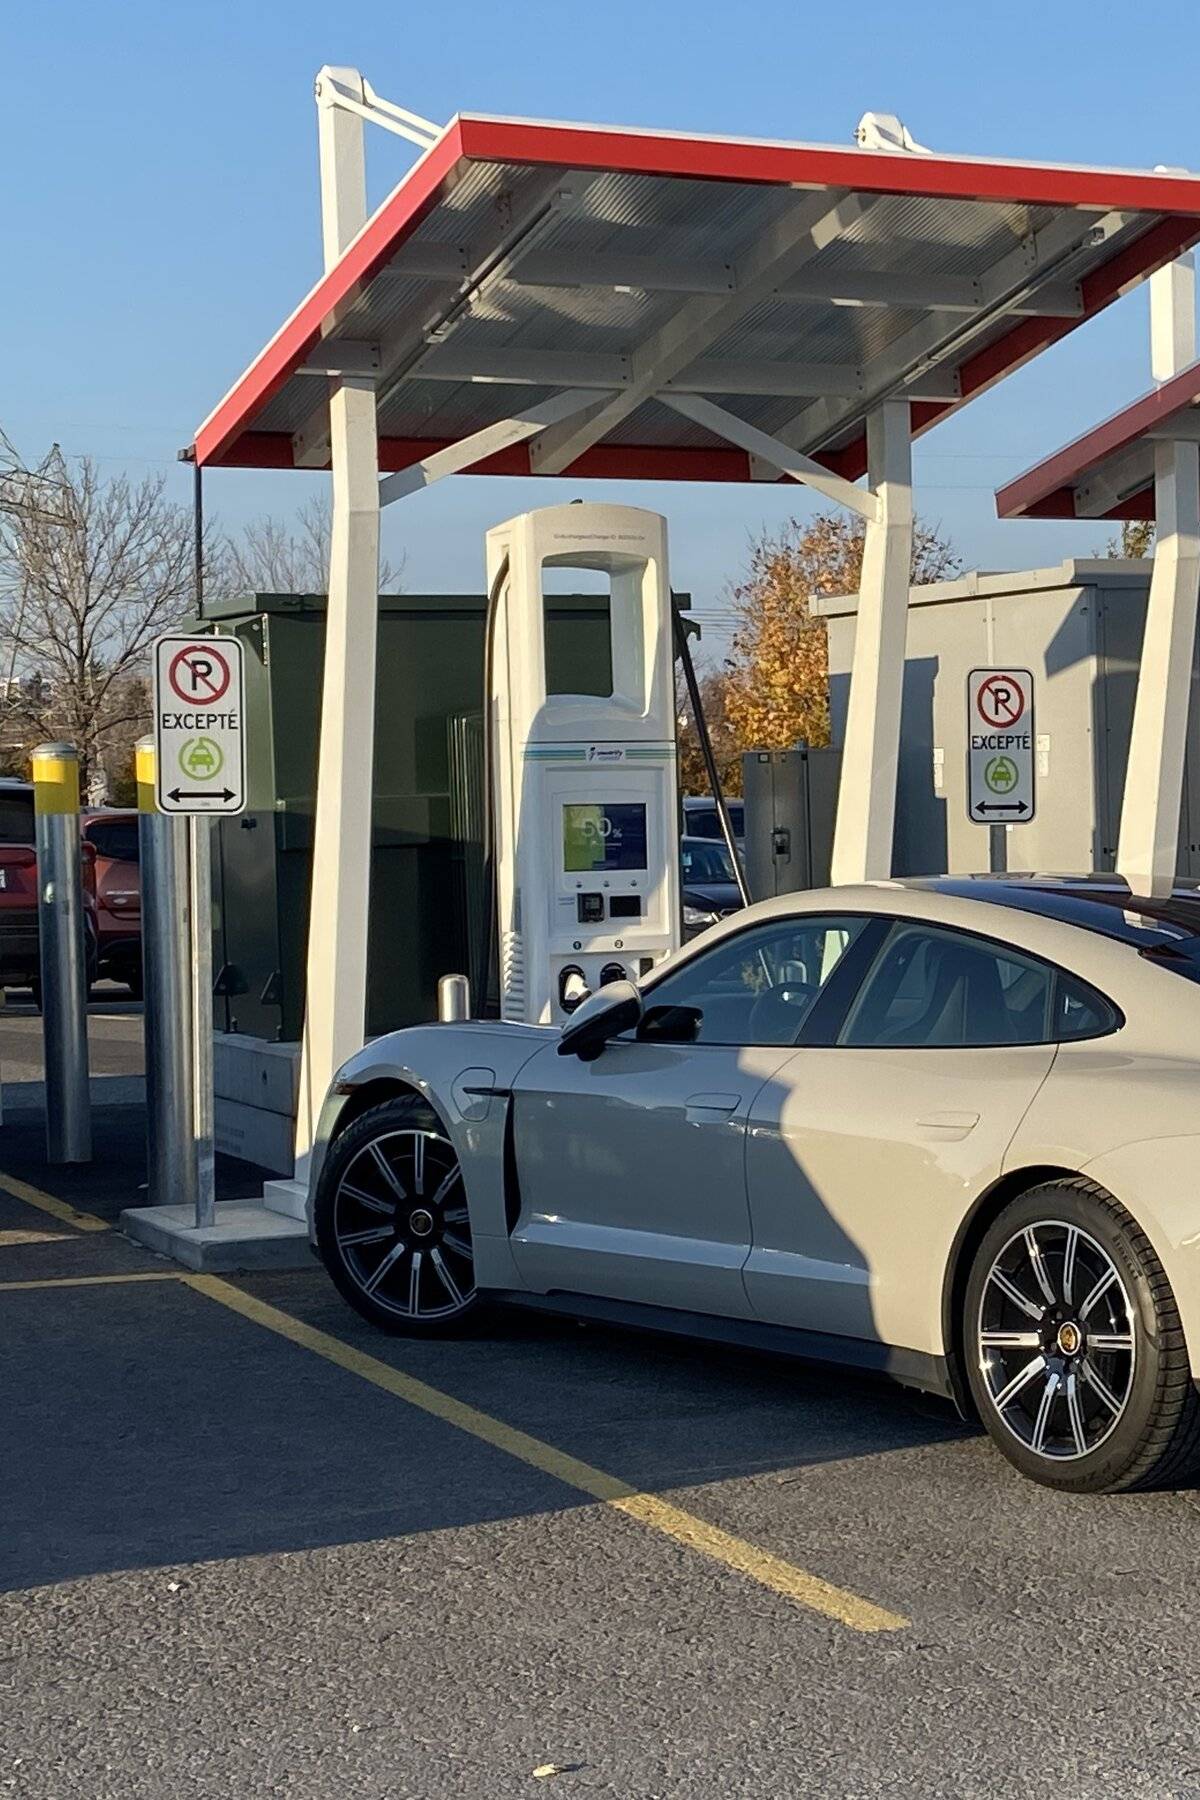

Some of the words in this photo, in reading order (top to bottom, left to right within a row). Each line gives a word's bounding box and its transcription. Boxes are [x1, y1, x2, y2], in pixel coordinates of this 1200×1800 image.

[191, 660, 212, 690] P
[994, 688, 1011, 715] P
[162, 709, 238, 729] EXCEPTÉ
[972, 731, 1031, 750] EXCEPTÉ
